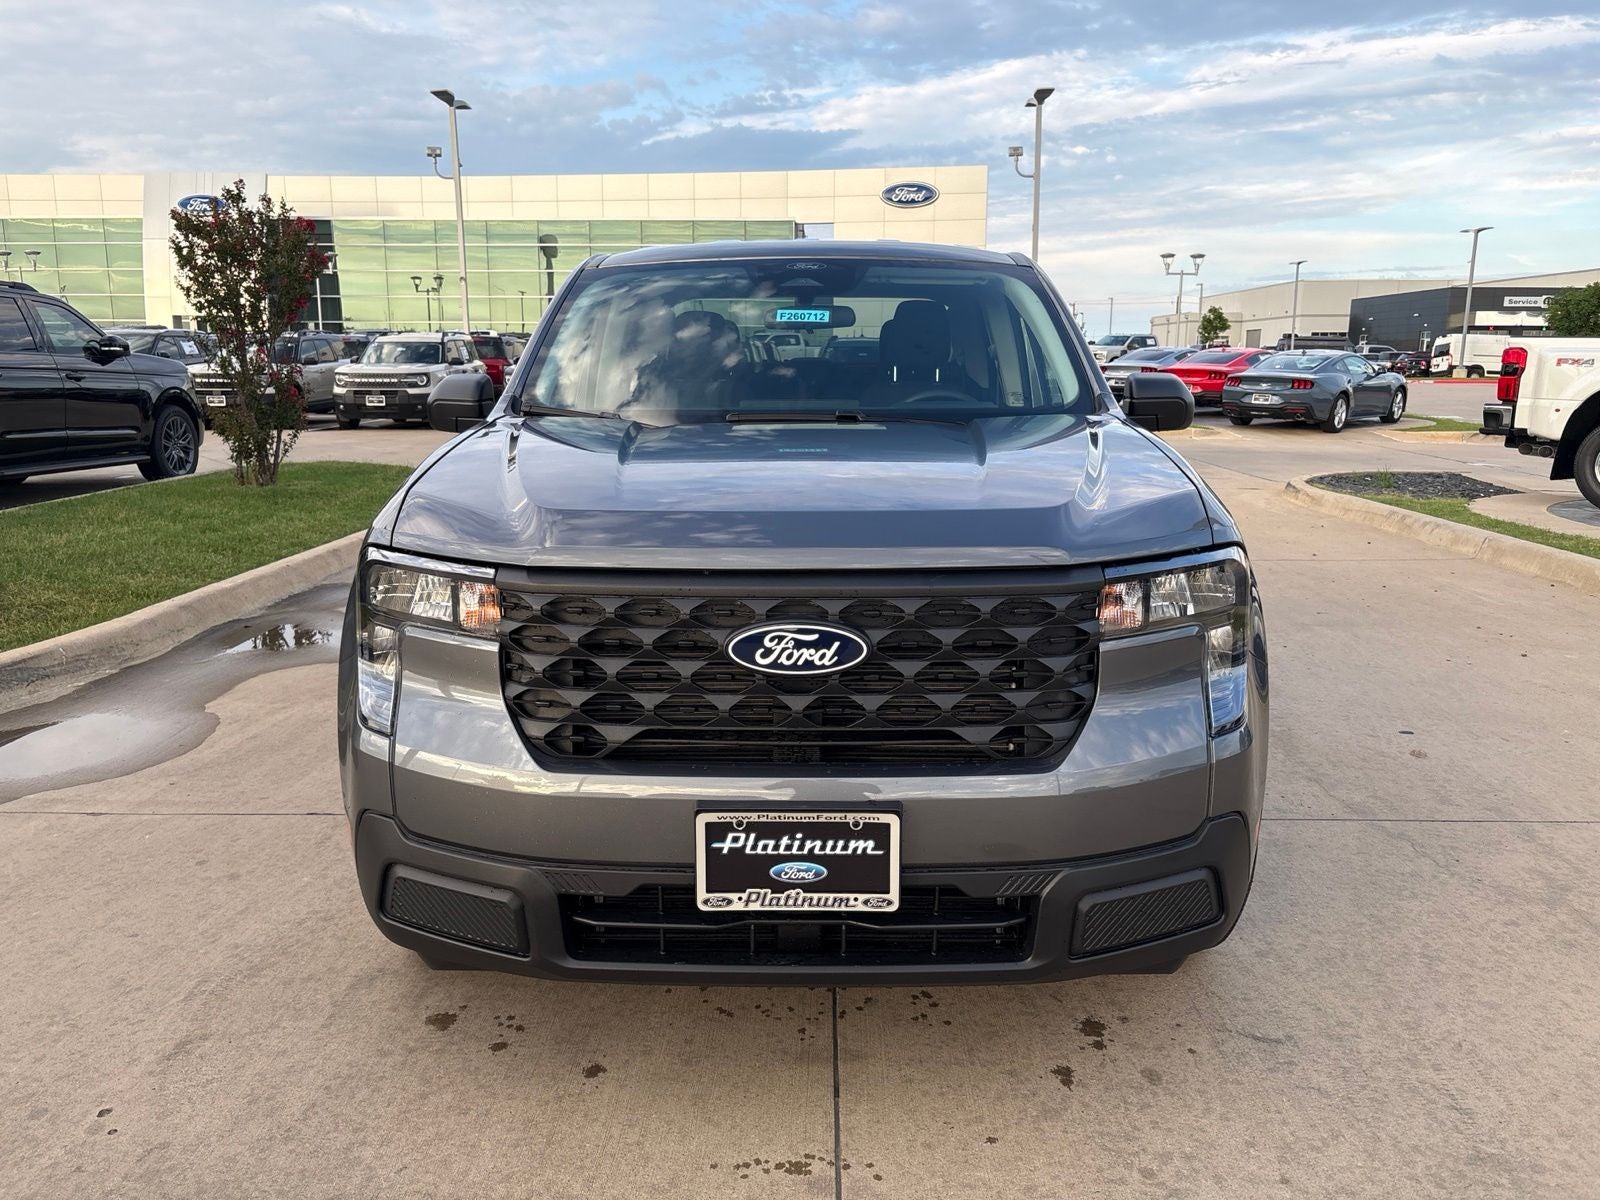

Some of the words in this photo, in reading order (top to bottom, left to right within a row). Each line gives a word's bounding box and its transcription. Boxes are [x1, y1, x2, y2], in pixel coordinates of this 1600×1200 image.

[892, 187, 926, 202] Ford
[780, 312, 826, 321] F260712
[1555, 358, 1595, 367] FX4
[755, 631, 841, 665] Ford
[711, 832, 884, 855] Platinum
[781, 864, 815, 879] Ford
[707, 897, 727, 907] Ford
[739, 891, 859, 908] Platinum
[867, 897, 888, 908] Ford
